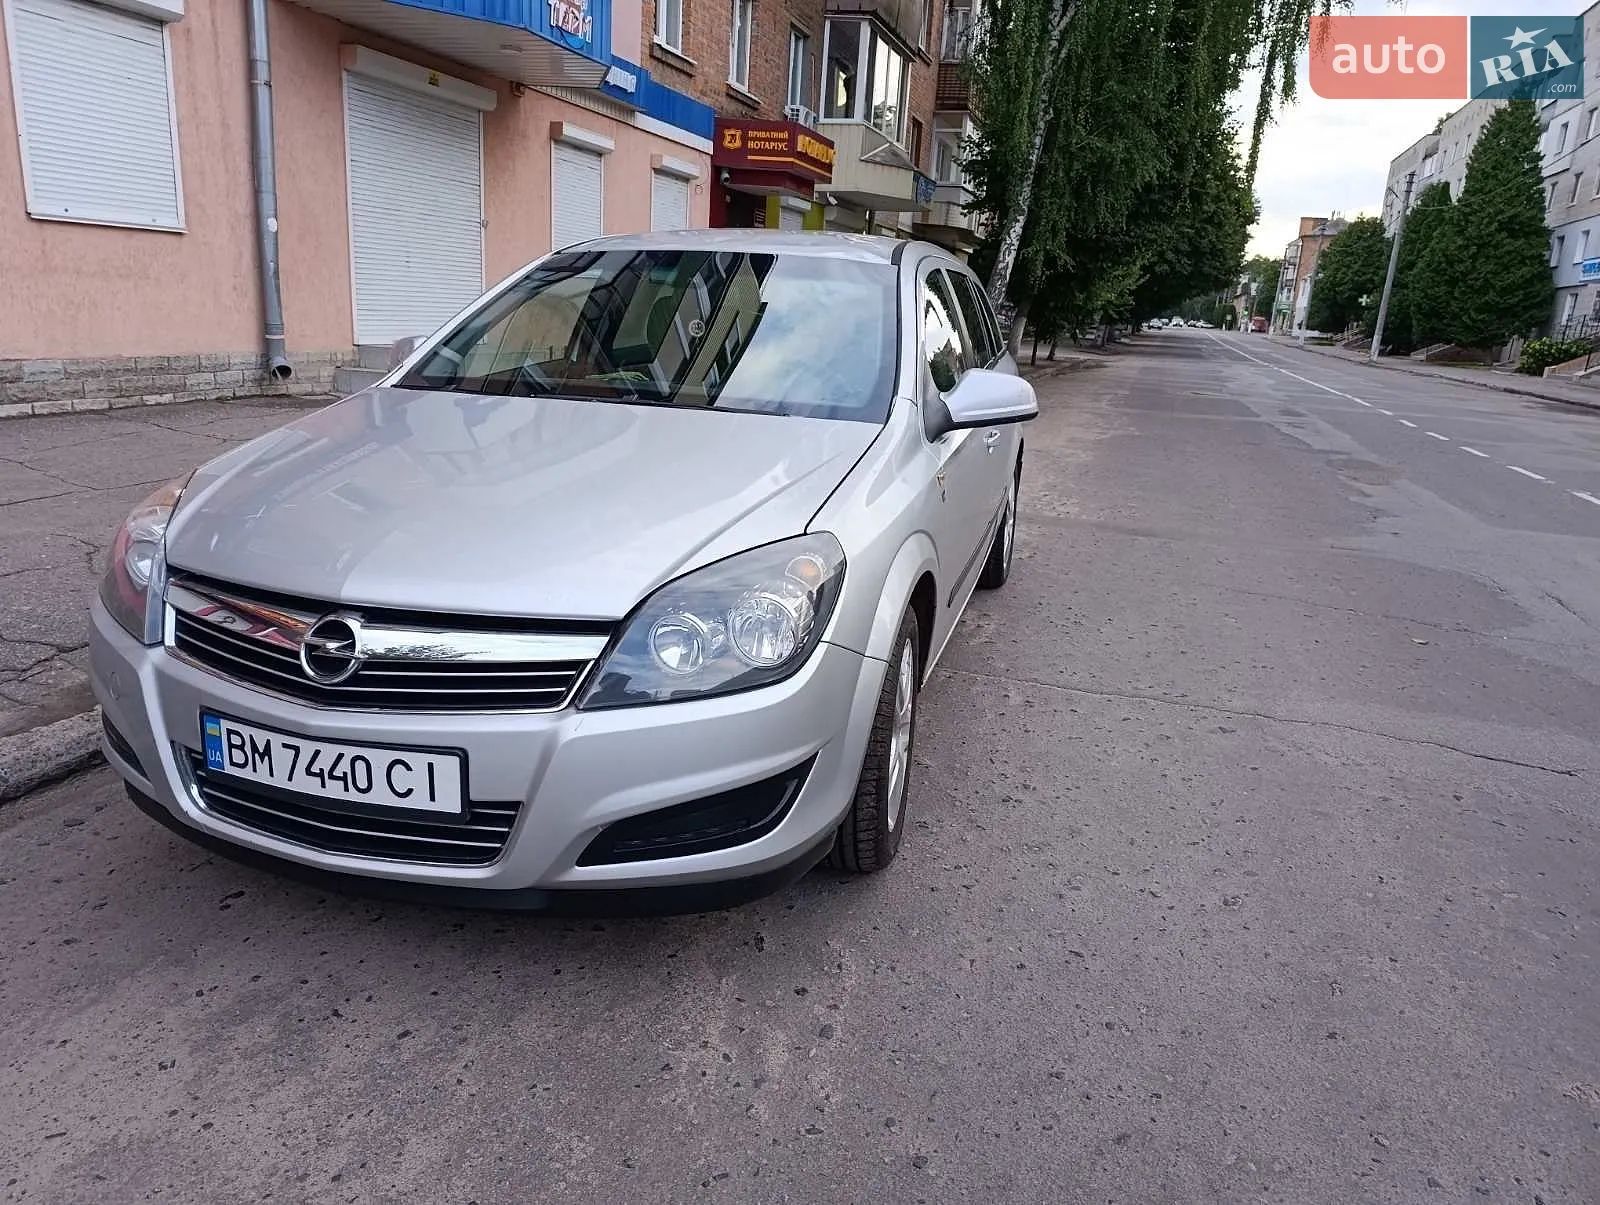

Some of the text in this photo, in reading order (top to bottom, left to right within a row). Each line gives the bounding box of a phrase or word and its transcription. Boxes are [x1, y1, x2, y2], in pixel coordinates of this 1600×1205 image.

[748, 130, 789, 139] ПРИВАТНИЙ
[747, 141, 789, 151] НОТАРІУС
[208, 749, 222, 763] UA
[225, 727, 274, 777] BM
[281, 742, 373, 794] 7440
